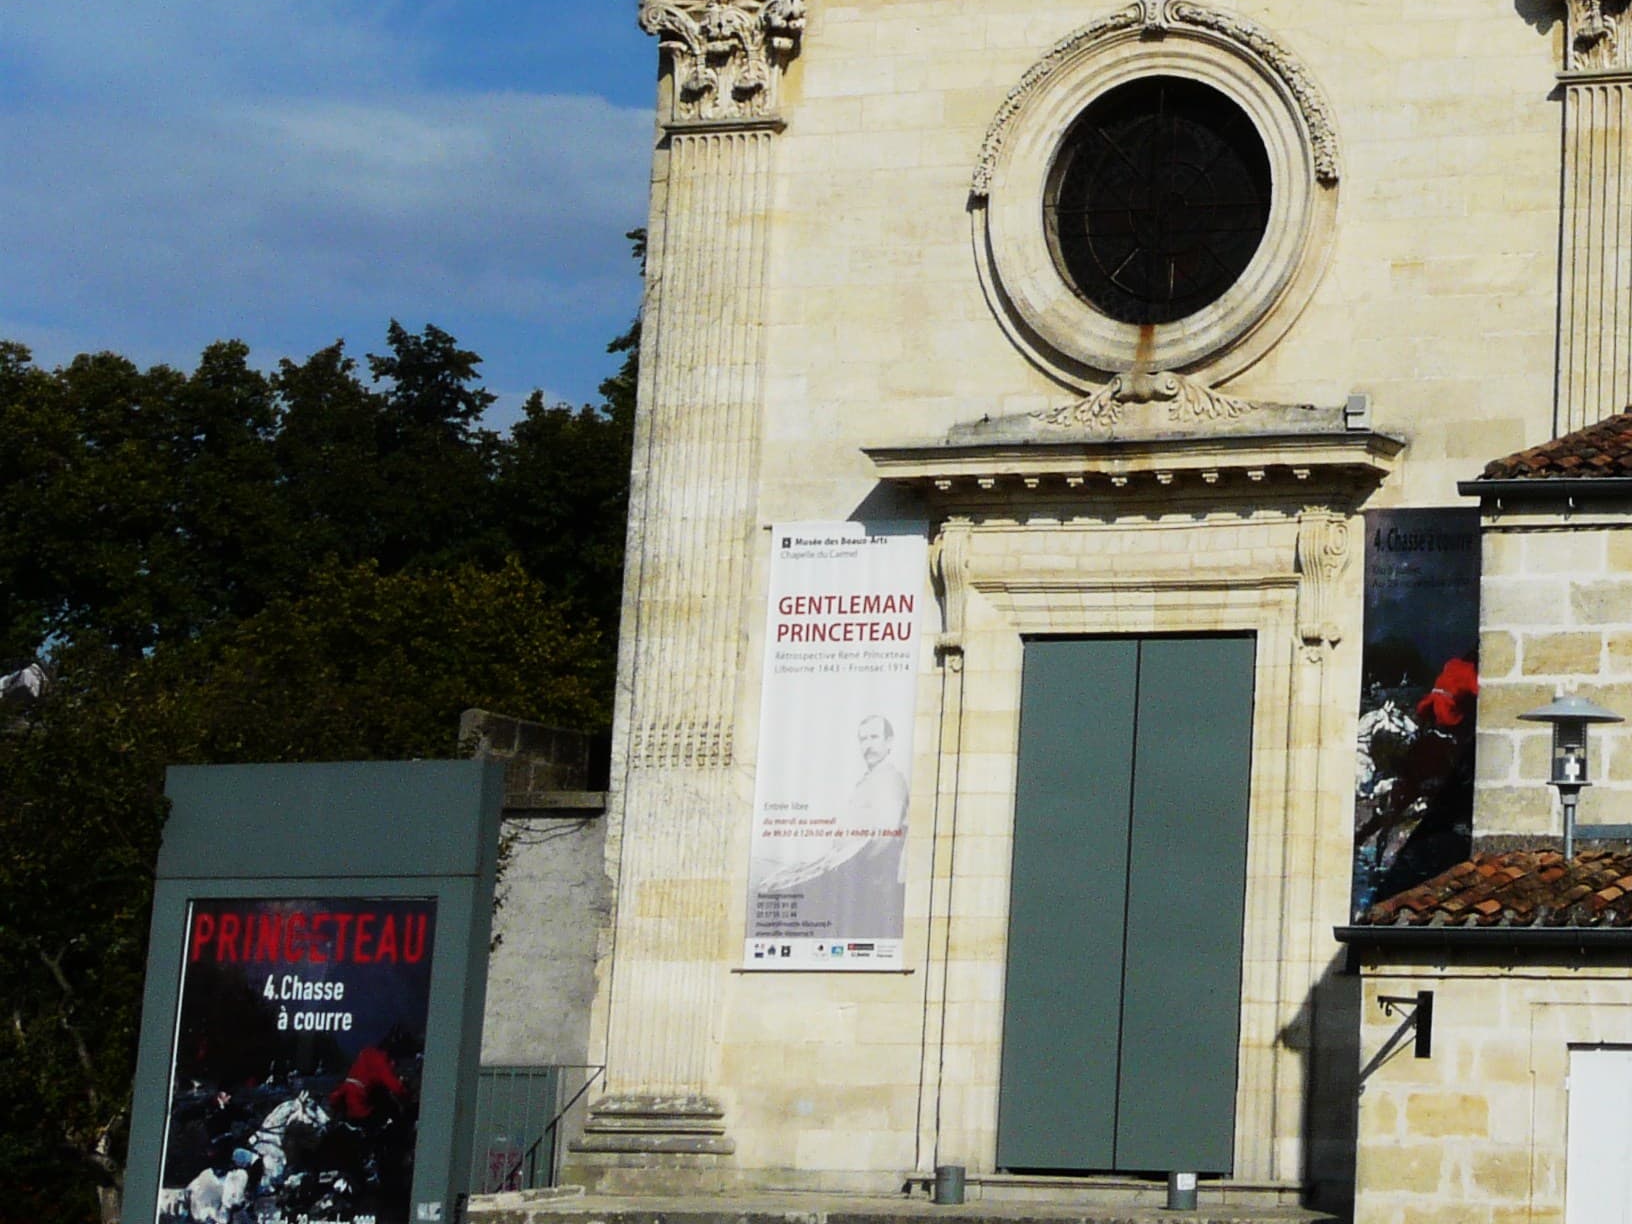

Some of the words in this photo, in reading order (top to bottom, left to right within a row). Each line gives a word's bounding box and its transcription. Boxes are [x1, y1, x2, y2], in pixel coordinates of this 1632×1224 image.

[778, 594, 914, 615] GENTLEMAN
[777, 622, 912, 643] PRINCETEAU
[191, 912, 428, 964] PRINCETEAU
[276, 1006, 289, 1031] à
[294, 1009, 353, 1031] courre
